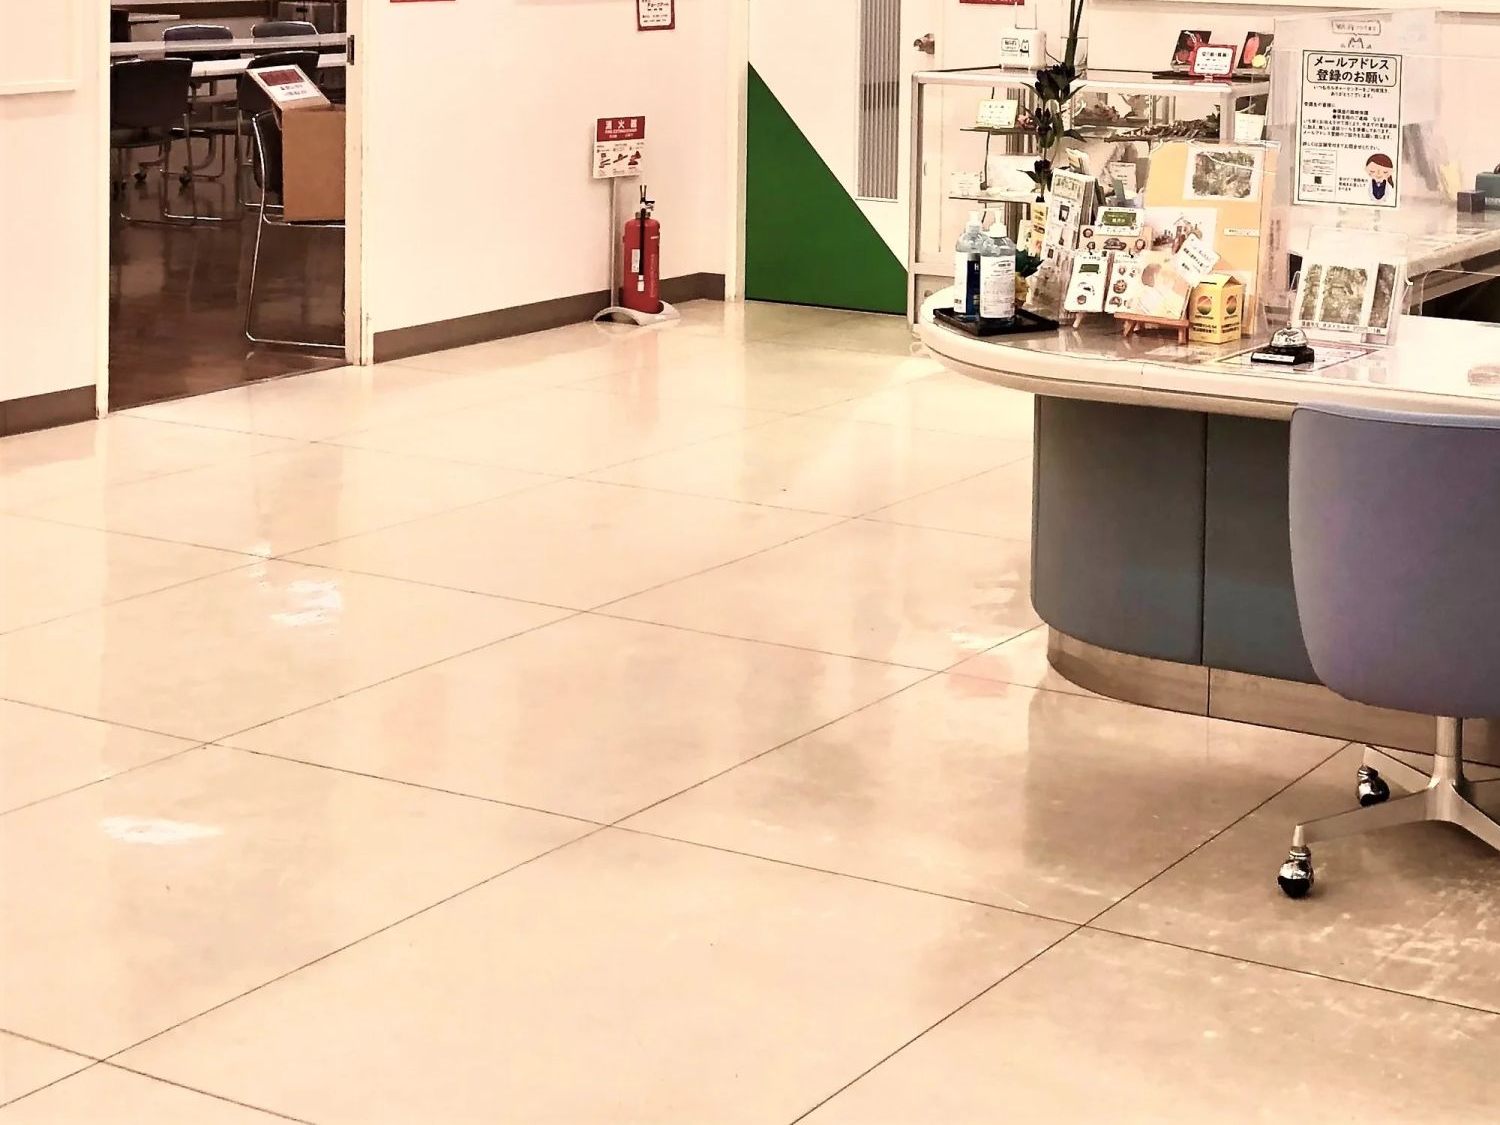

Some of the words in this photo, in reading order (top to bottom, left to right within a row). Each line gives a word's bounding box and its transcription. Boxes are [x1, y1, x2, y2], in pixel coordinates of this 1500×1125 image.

[1313, 56, 1390, 71] メールアドレス
[1316, 69, 1390, 85] 登録のお願い
